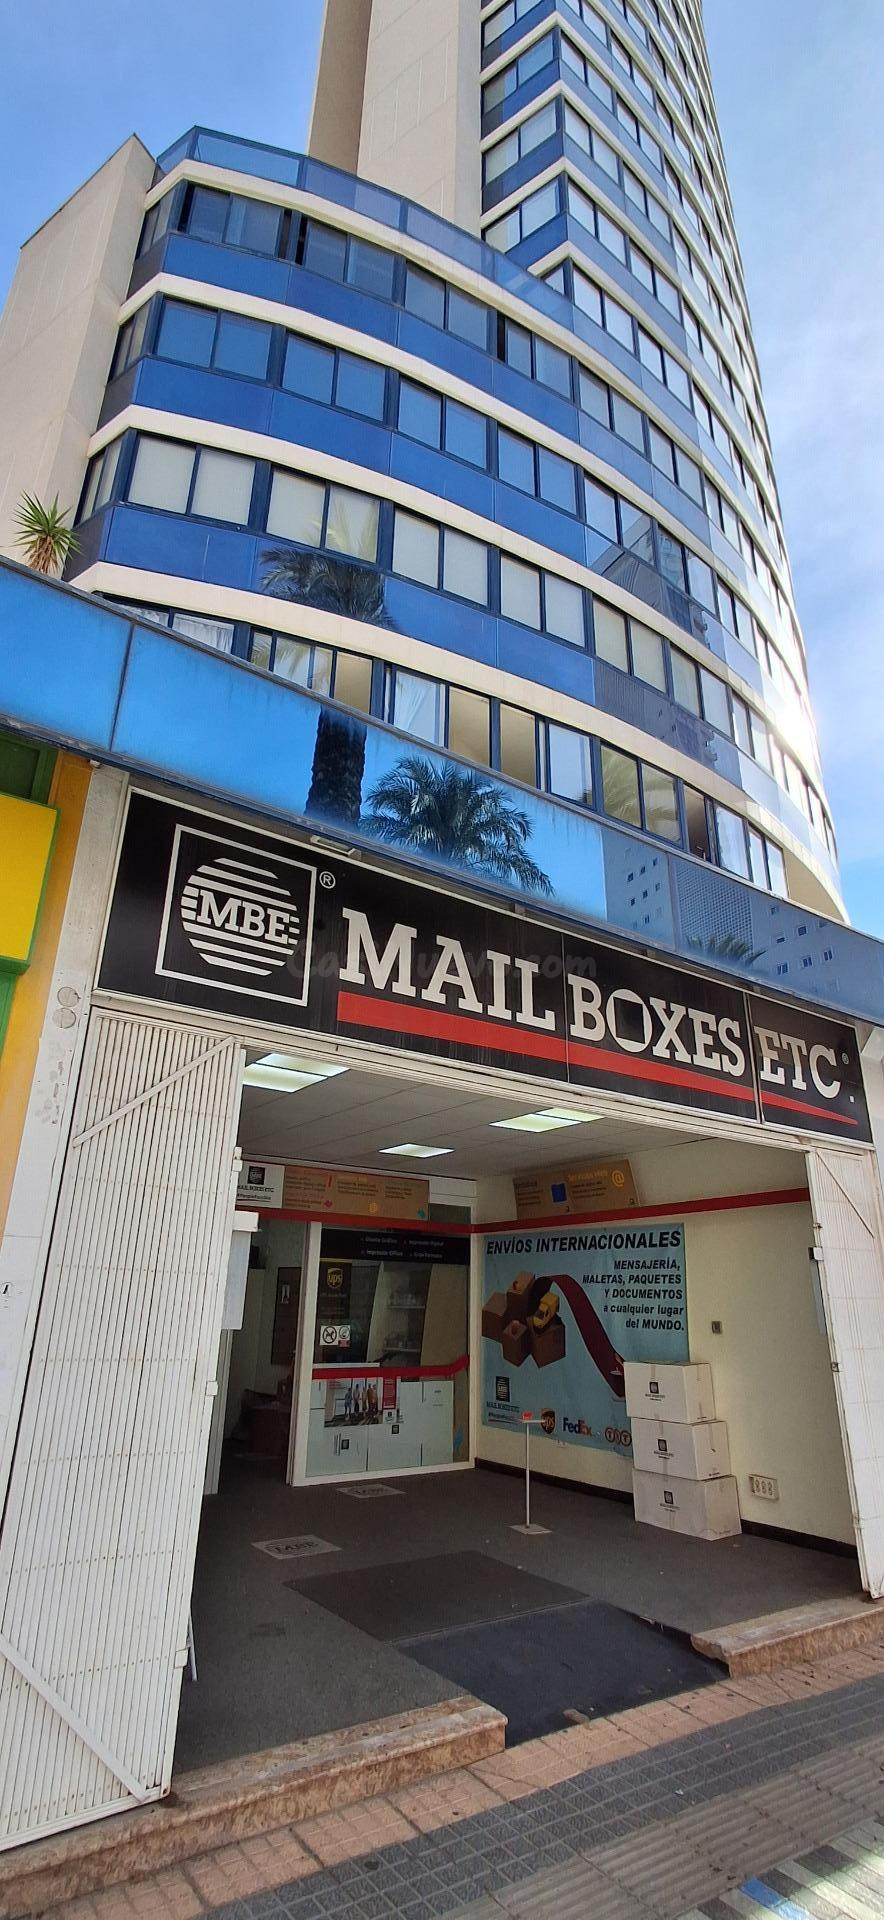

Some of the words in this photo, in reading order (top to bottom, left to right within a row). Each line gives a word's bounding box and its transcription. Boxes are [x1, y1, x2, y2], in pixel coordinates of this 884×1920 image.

[197, 889, 289, 943] MBE
[339, 907, 555, 1031] MAIL
[568, 973, 746, 1077] BOXES
[486, 1237, 533, 1255] ENVÍOS
[536, 1230, 681, 1253] INTERNACIONALES
[614, 1257, 680, 1271] MENSAJERÍA,
[582, 1274, 626, 1286] MALETAS,
[628, 1274, 682, 1285] PAQUETES
[604, 1289, 610, 1298] Y
[612, 1288, 683, 1300] DOCUMENTOS
[603, 1305, 609, 1313] a
[610, 1304, 654, 1316] cualquier
[657, 1304, 684, 1318] lugar
[625, 1318, 639, 1329] del
[642, 1318, 685, 1331] MUNDO.
[563, 1417, 592, 1437] FedEx
